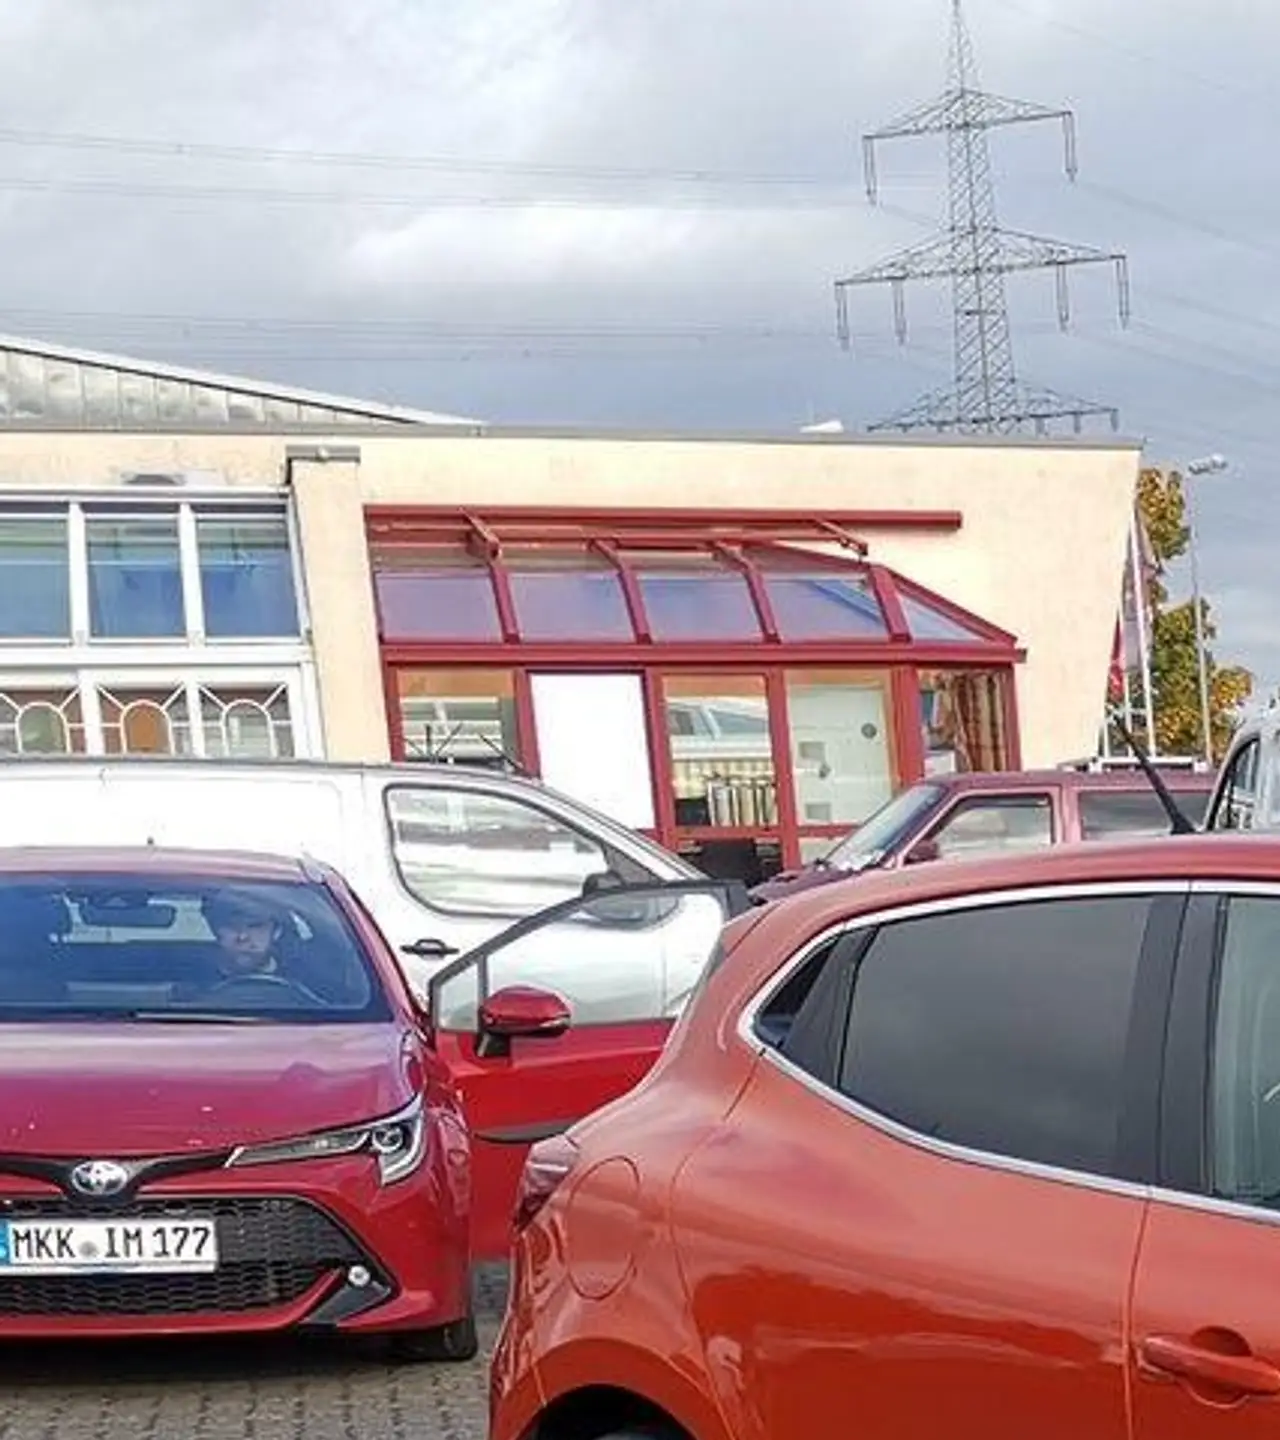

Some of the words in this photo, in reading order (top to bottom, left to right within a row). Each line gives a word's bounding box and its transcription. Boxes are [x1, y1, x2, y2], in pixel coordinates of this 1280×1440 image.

[12, 1227, 76, 1259] MKK
[104, 1227, 143, 1259] IM
[152, 1226, 211, 1257] 177
